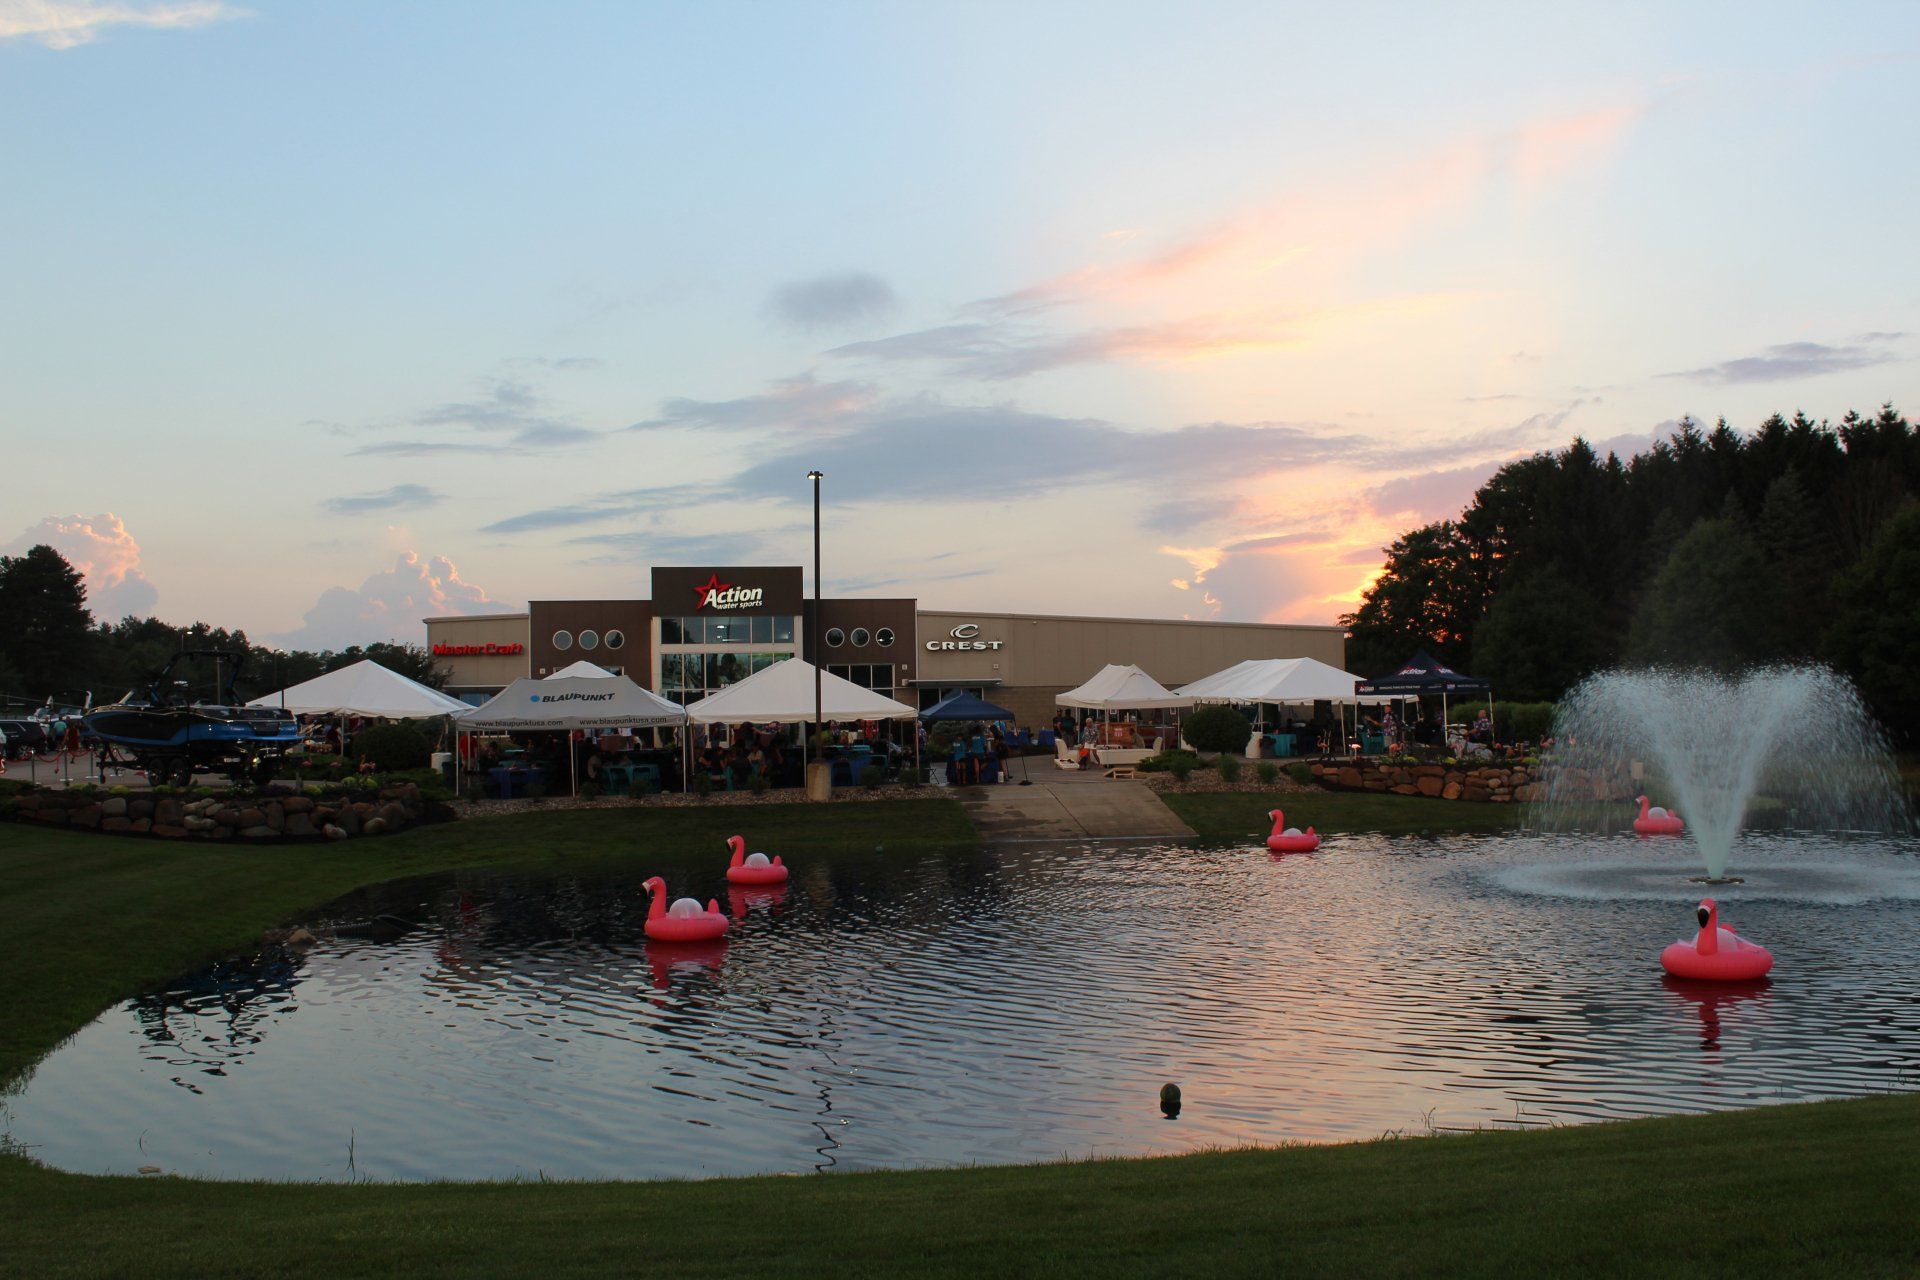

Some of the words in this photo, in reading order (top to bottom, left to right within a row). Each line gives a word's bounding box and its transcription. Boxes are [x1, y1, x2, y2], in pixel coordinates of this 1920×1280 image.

[703, 586, 763, 609] Action
[716, 602, 739, 610] water
[740, 600, 763, 609] sports
[926, 641, 1003, 651] CREST
[542, 693, 616, 703] BLAUPUNKT
[580, 717, 667, 725] www.blaupunktusa.com
